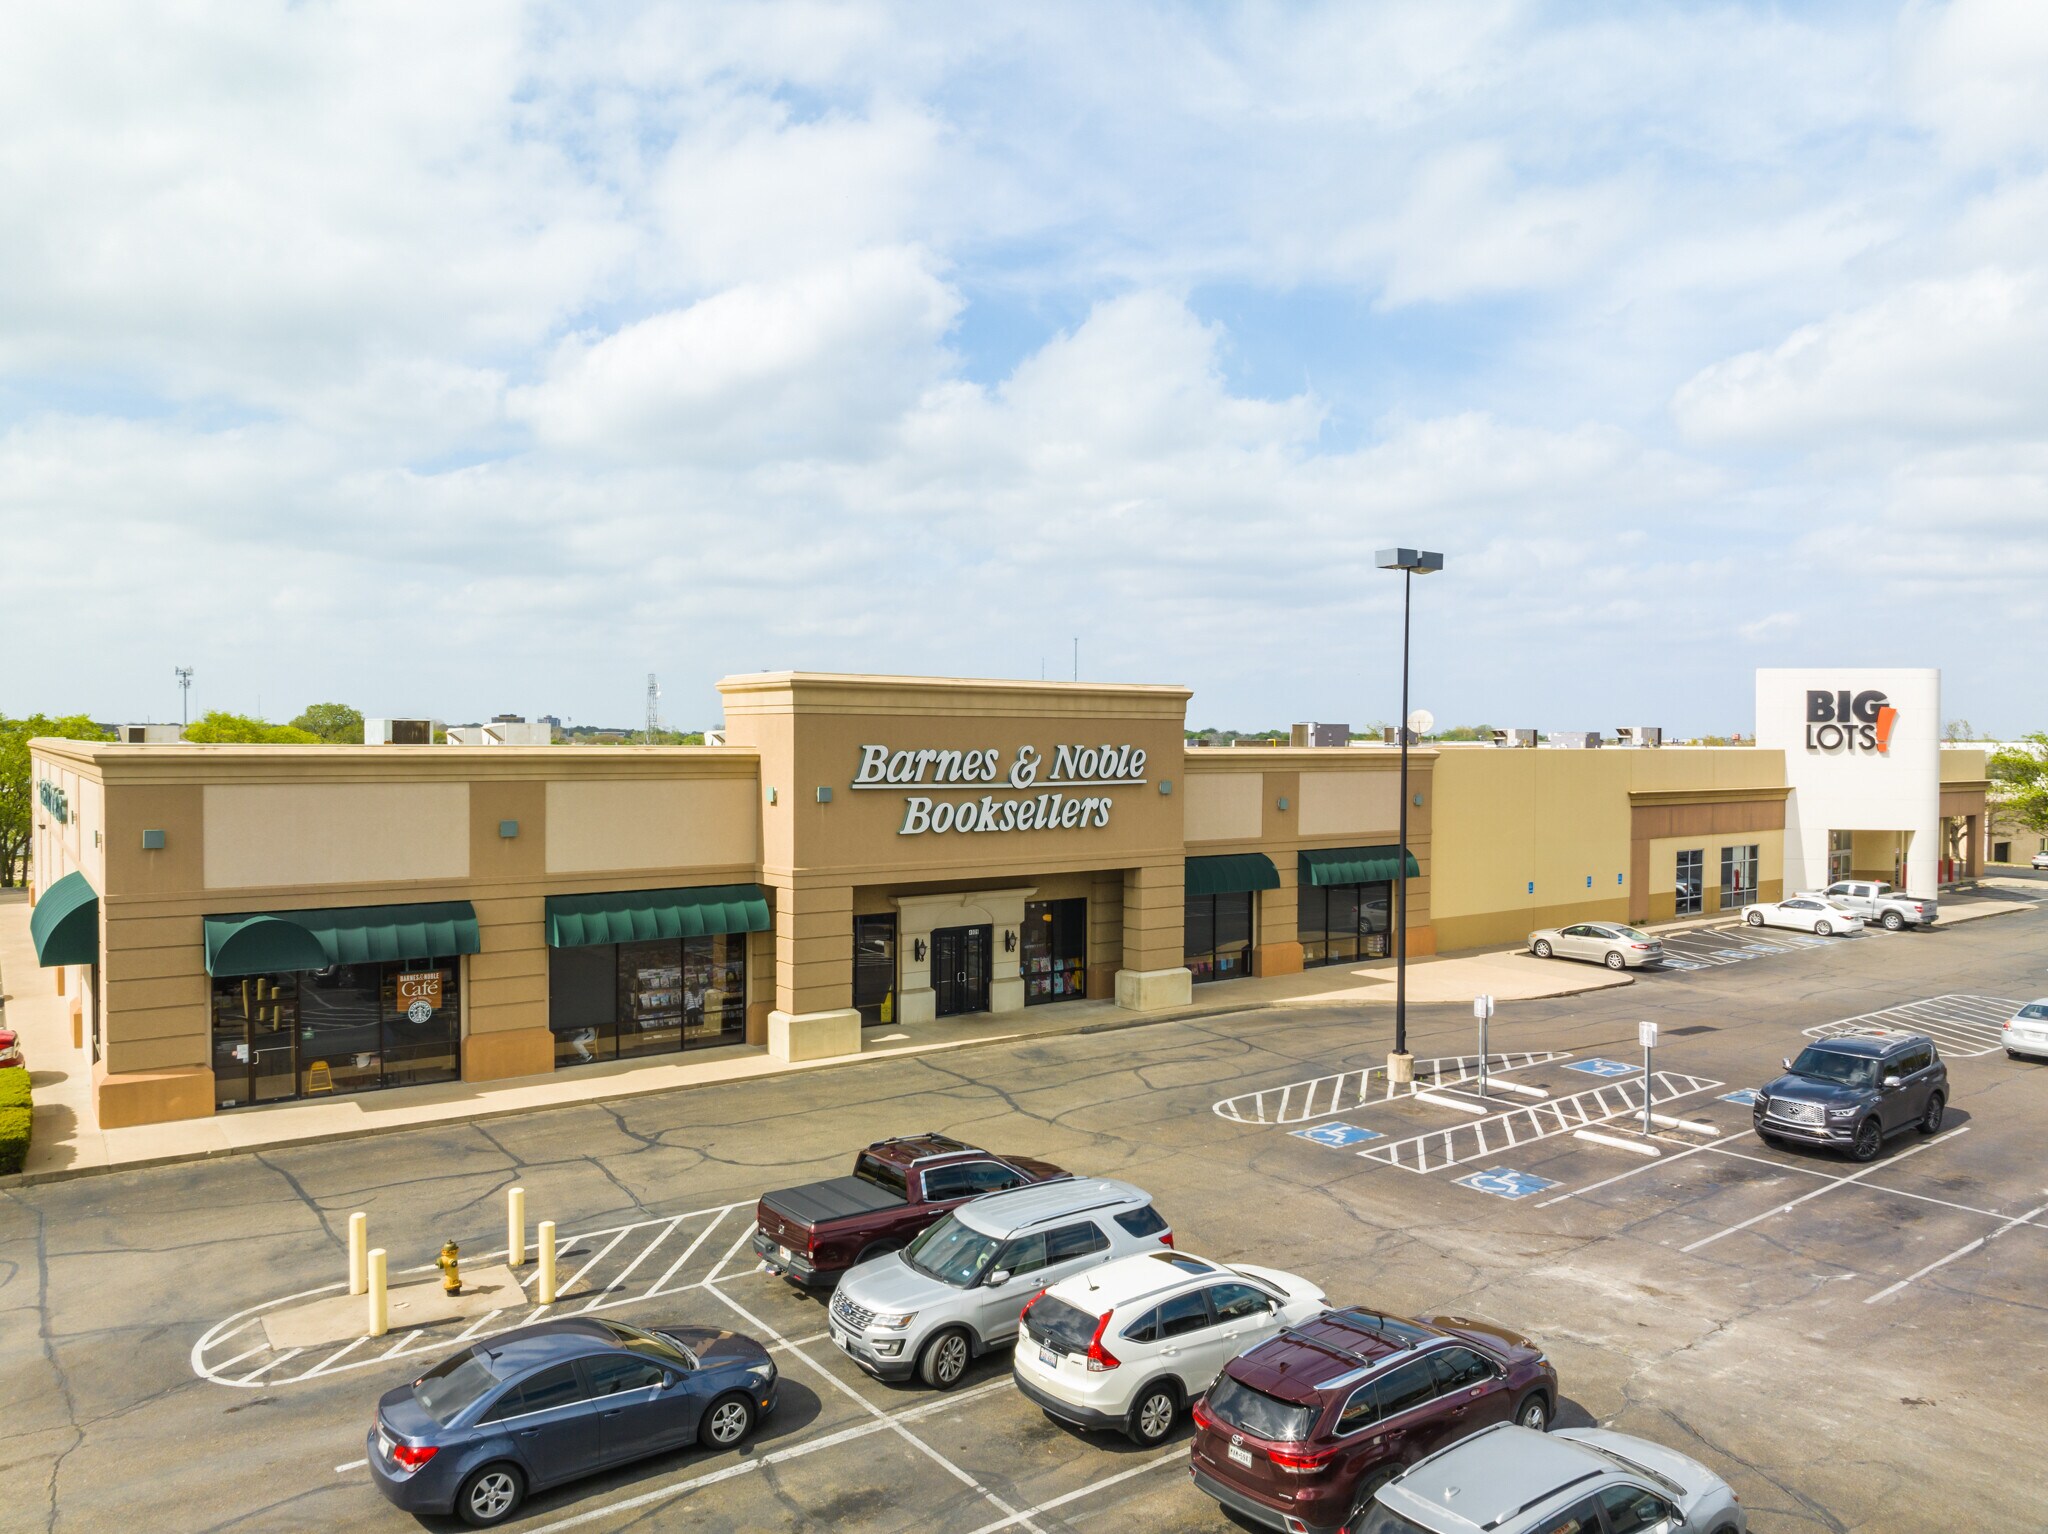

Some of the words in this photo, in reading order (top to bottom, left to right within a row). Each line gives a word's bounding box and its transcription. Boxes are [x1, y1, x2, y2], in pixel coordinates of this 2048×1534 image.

[1806, 690, 1889, 723] BIG
[854, 745, 999, 783] Barnes
[1009, 745, 1041, 789] &
[1048, 745, 1147, 779] Noble
[898, 794, 1112, 834] Booksellers
[401, 980, 438, 997] Café
